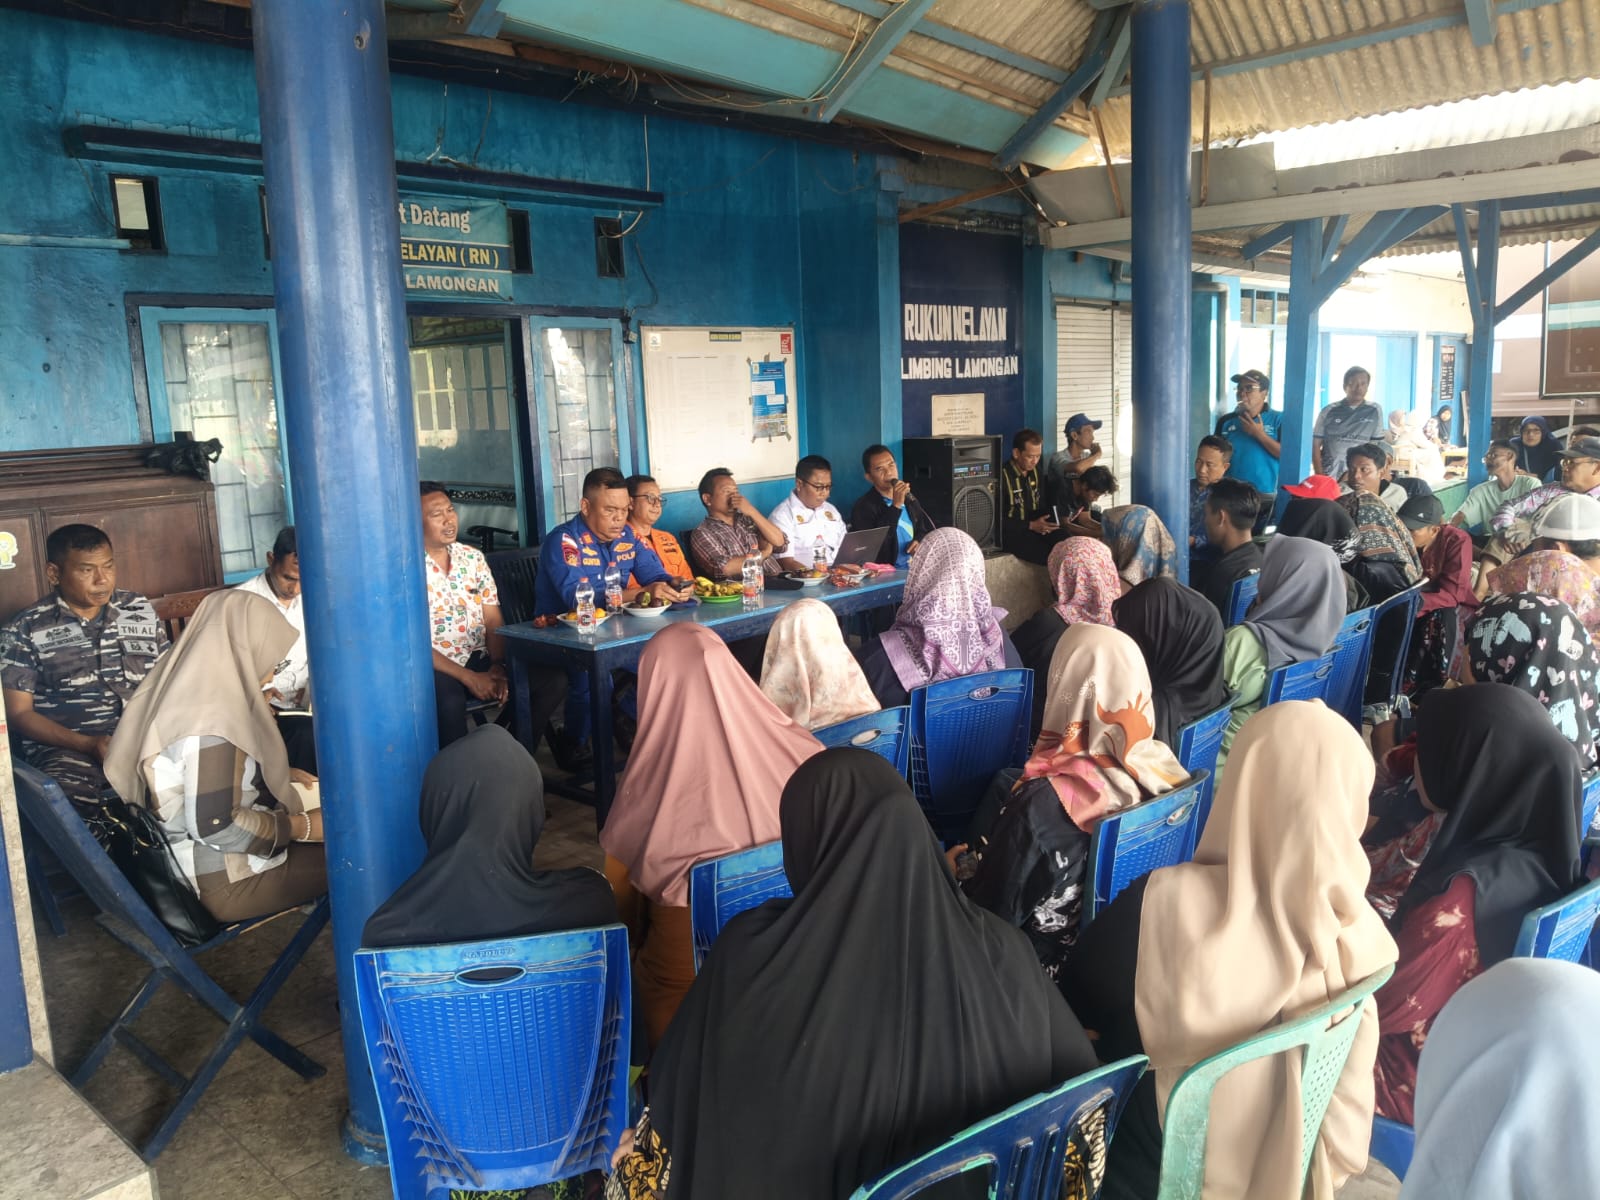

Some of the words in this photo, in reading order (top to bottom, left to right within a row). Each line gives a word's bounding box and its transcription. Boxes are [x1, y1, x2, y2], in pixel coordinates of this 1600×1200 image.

[410, 203, 471, 234] Datang
[401, 242, 457, 263] ELAYAN
[405, 273, 499, 293] LAMONGAN
[904, 303, 951, 342] RUKUN
[952, 305, 1007, 342] NELAYAN
[900, 356, 952, 380] LIMBING
[955, 355, 1018, 378] LAMONGAN
[121, 625, 138, 634] TNI
[141, 626, 154, 635] AL
